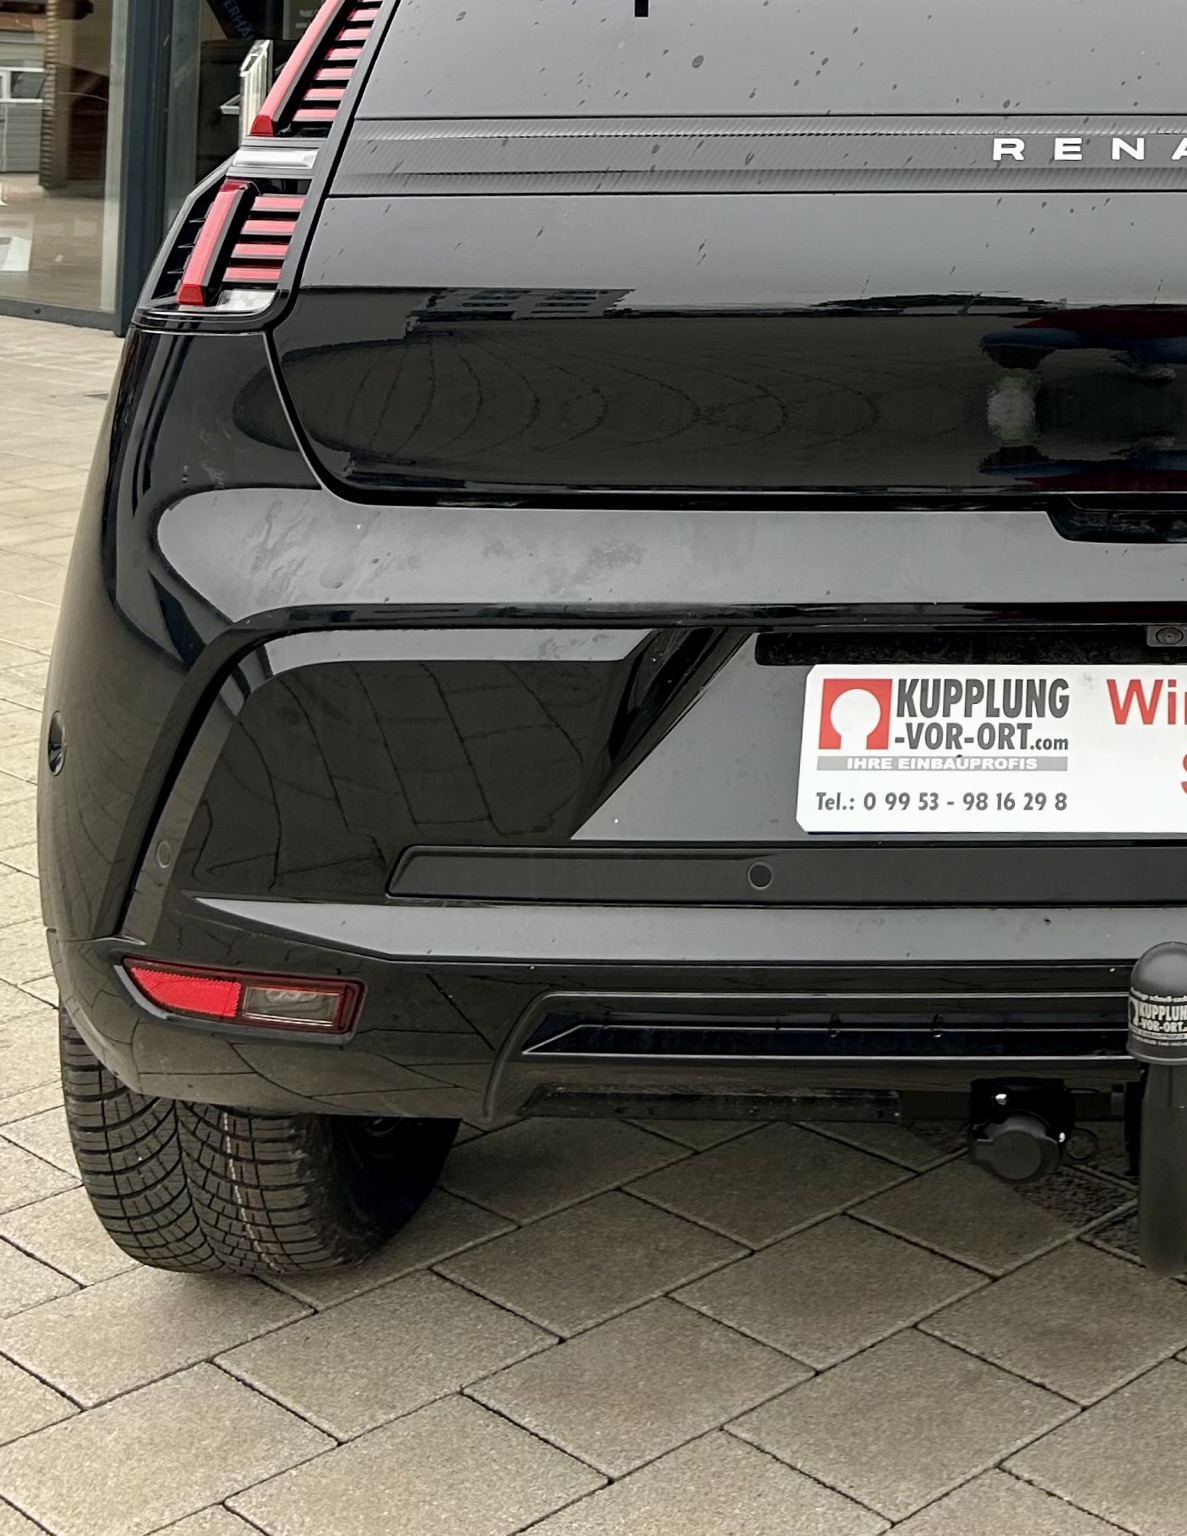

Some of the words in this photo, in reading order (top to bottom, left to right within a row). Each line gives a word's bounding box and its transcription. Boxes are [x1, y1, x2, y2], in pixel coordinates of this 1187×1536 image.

[897, 677, 1070, 718] KUPPLUNG
[894, 722, 1069, 750] -VOR-ORT.com
[847, 757, 893, 770] IHRE
[897, 757, 1038, 770] EINBAUPROFIS
[816, 792, 854, 811] Tel.:
[863, 792, 876, 811] 0
[885, 792, 910, 811] 99
[918, 792, 939, 811] 53
[963, 792, 988, 811] 98
[996, 792, 1016, 811] 16
[1023, 792, 1047, 811] 29
[1055, 792, 1068, 811] 8
